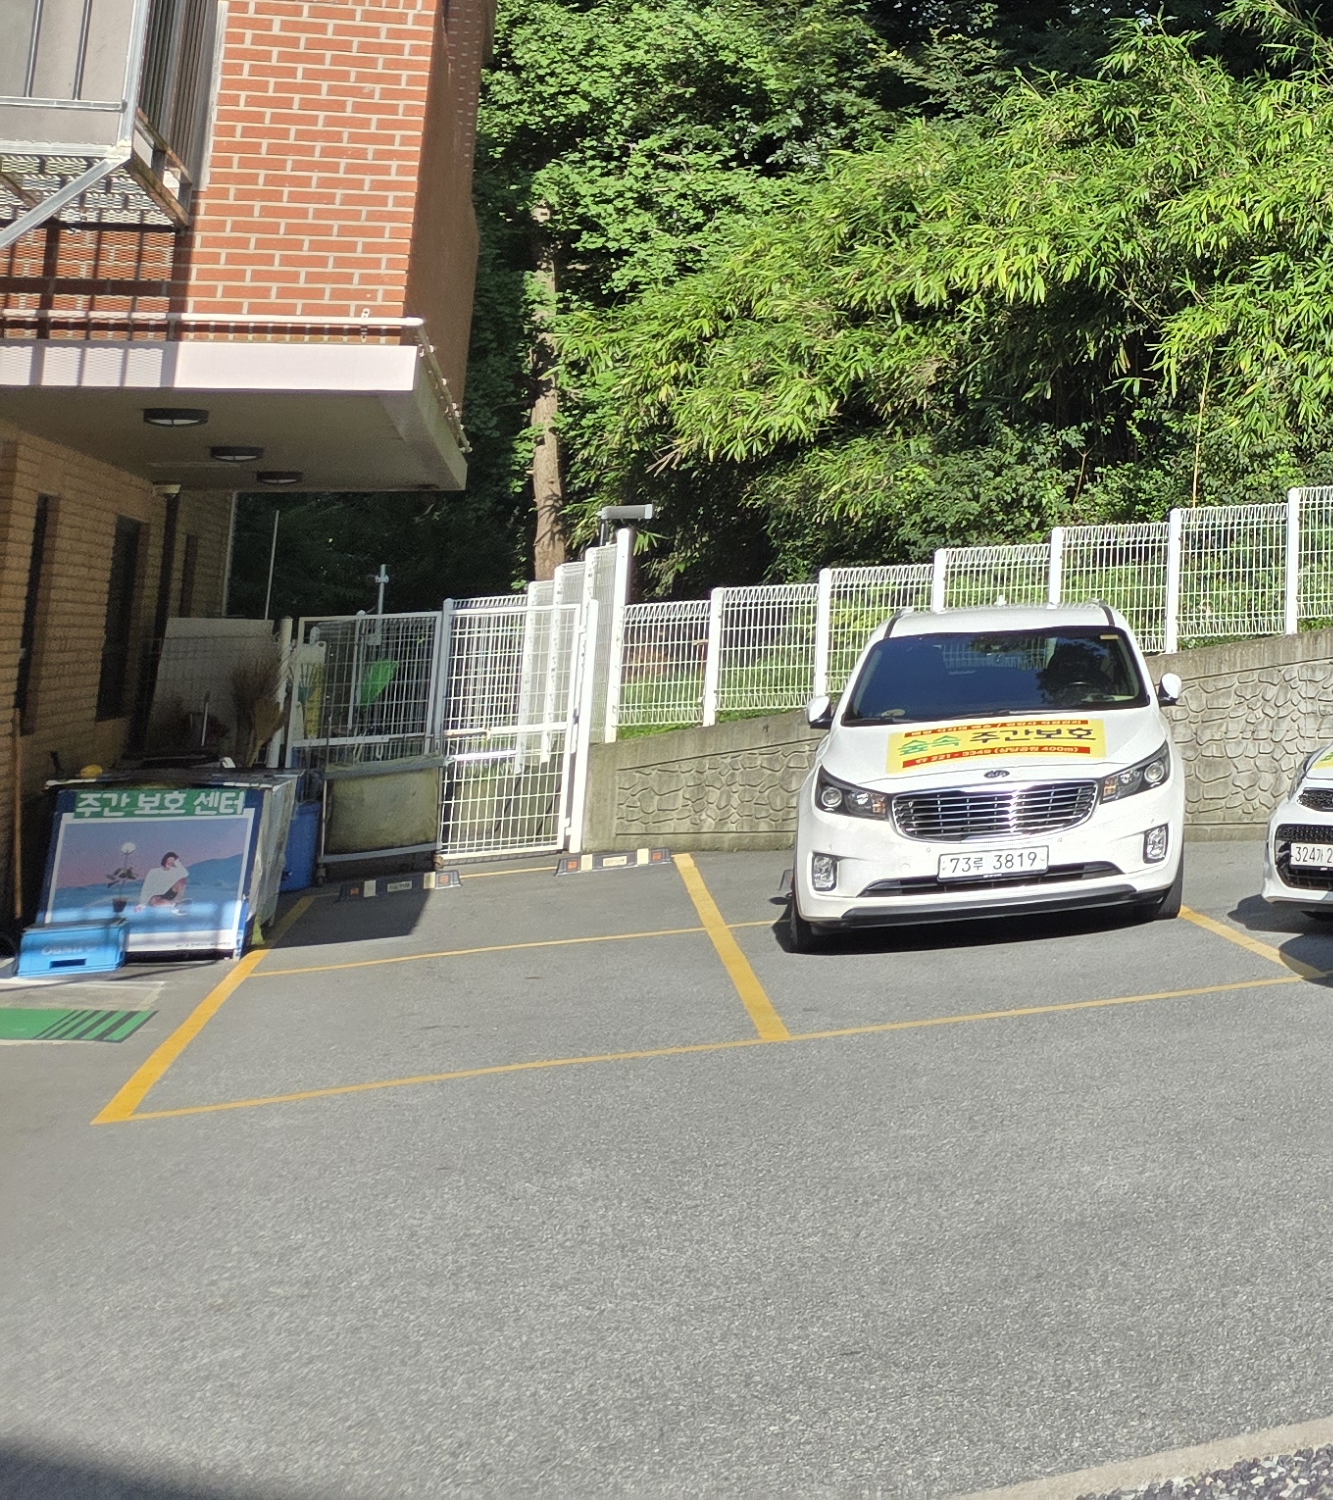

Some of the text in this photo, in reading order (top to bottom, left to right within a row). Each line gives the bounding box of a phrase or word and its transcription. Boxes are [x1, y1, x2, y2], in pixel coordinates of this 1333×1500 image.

[898, 735, 961, 756] 숲속
[969, 727, 1096, 743] 주간보호
[75, 790, 245, 817] 주간 보호 센터
[949, 851, 1038, 874] 73루 3819
[1294, 846, 1324, 863] 324가
